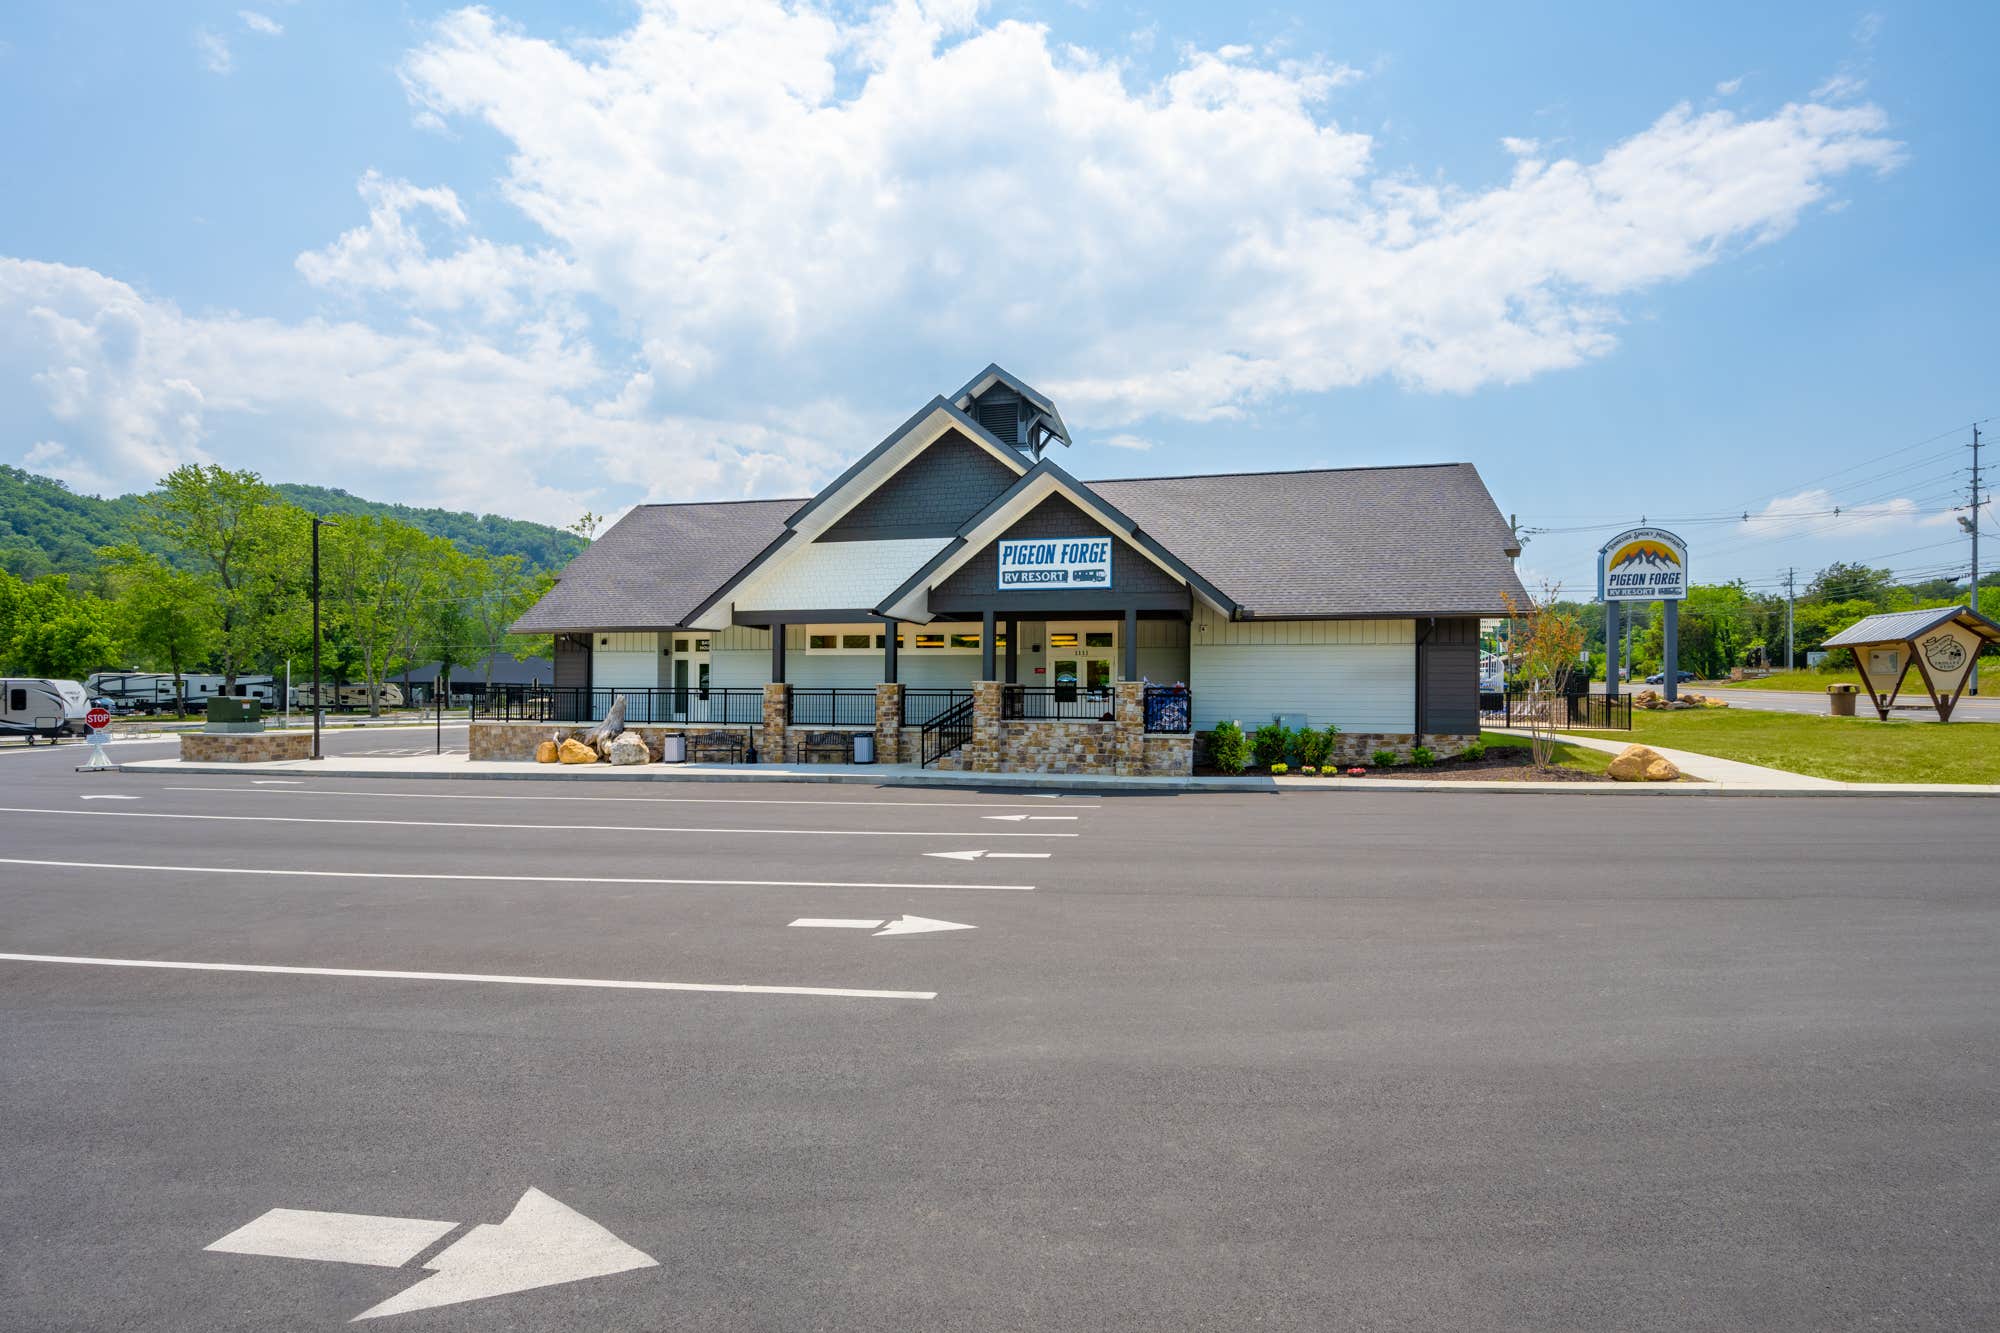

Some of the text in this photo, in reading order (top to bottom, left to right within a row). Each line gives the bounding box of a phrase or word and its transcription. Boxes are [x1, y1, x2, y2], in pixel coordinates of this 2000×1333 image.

[1002, 543, 1108, 565] PIGEON FORGE
[1004, 571, 1065, 582] RV RESORT
[1609, 572, 1681, 586] PIGEON FORGE
[87, 714, 109, 723] STOP
